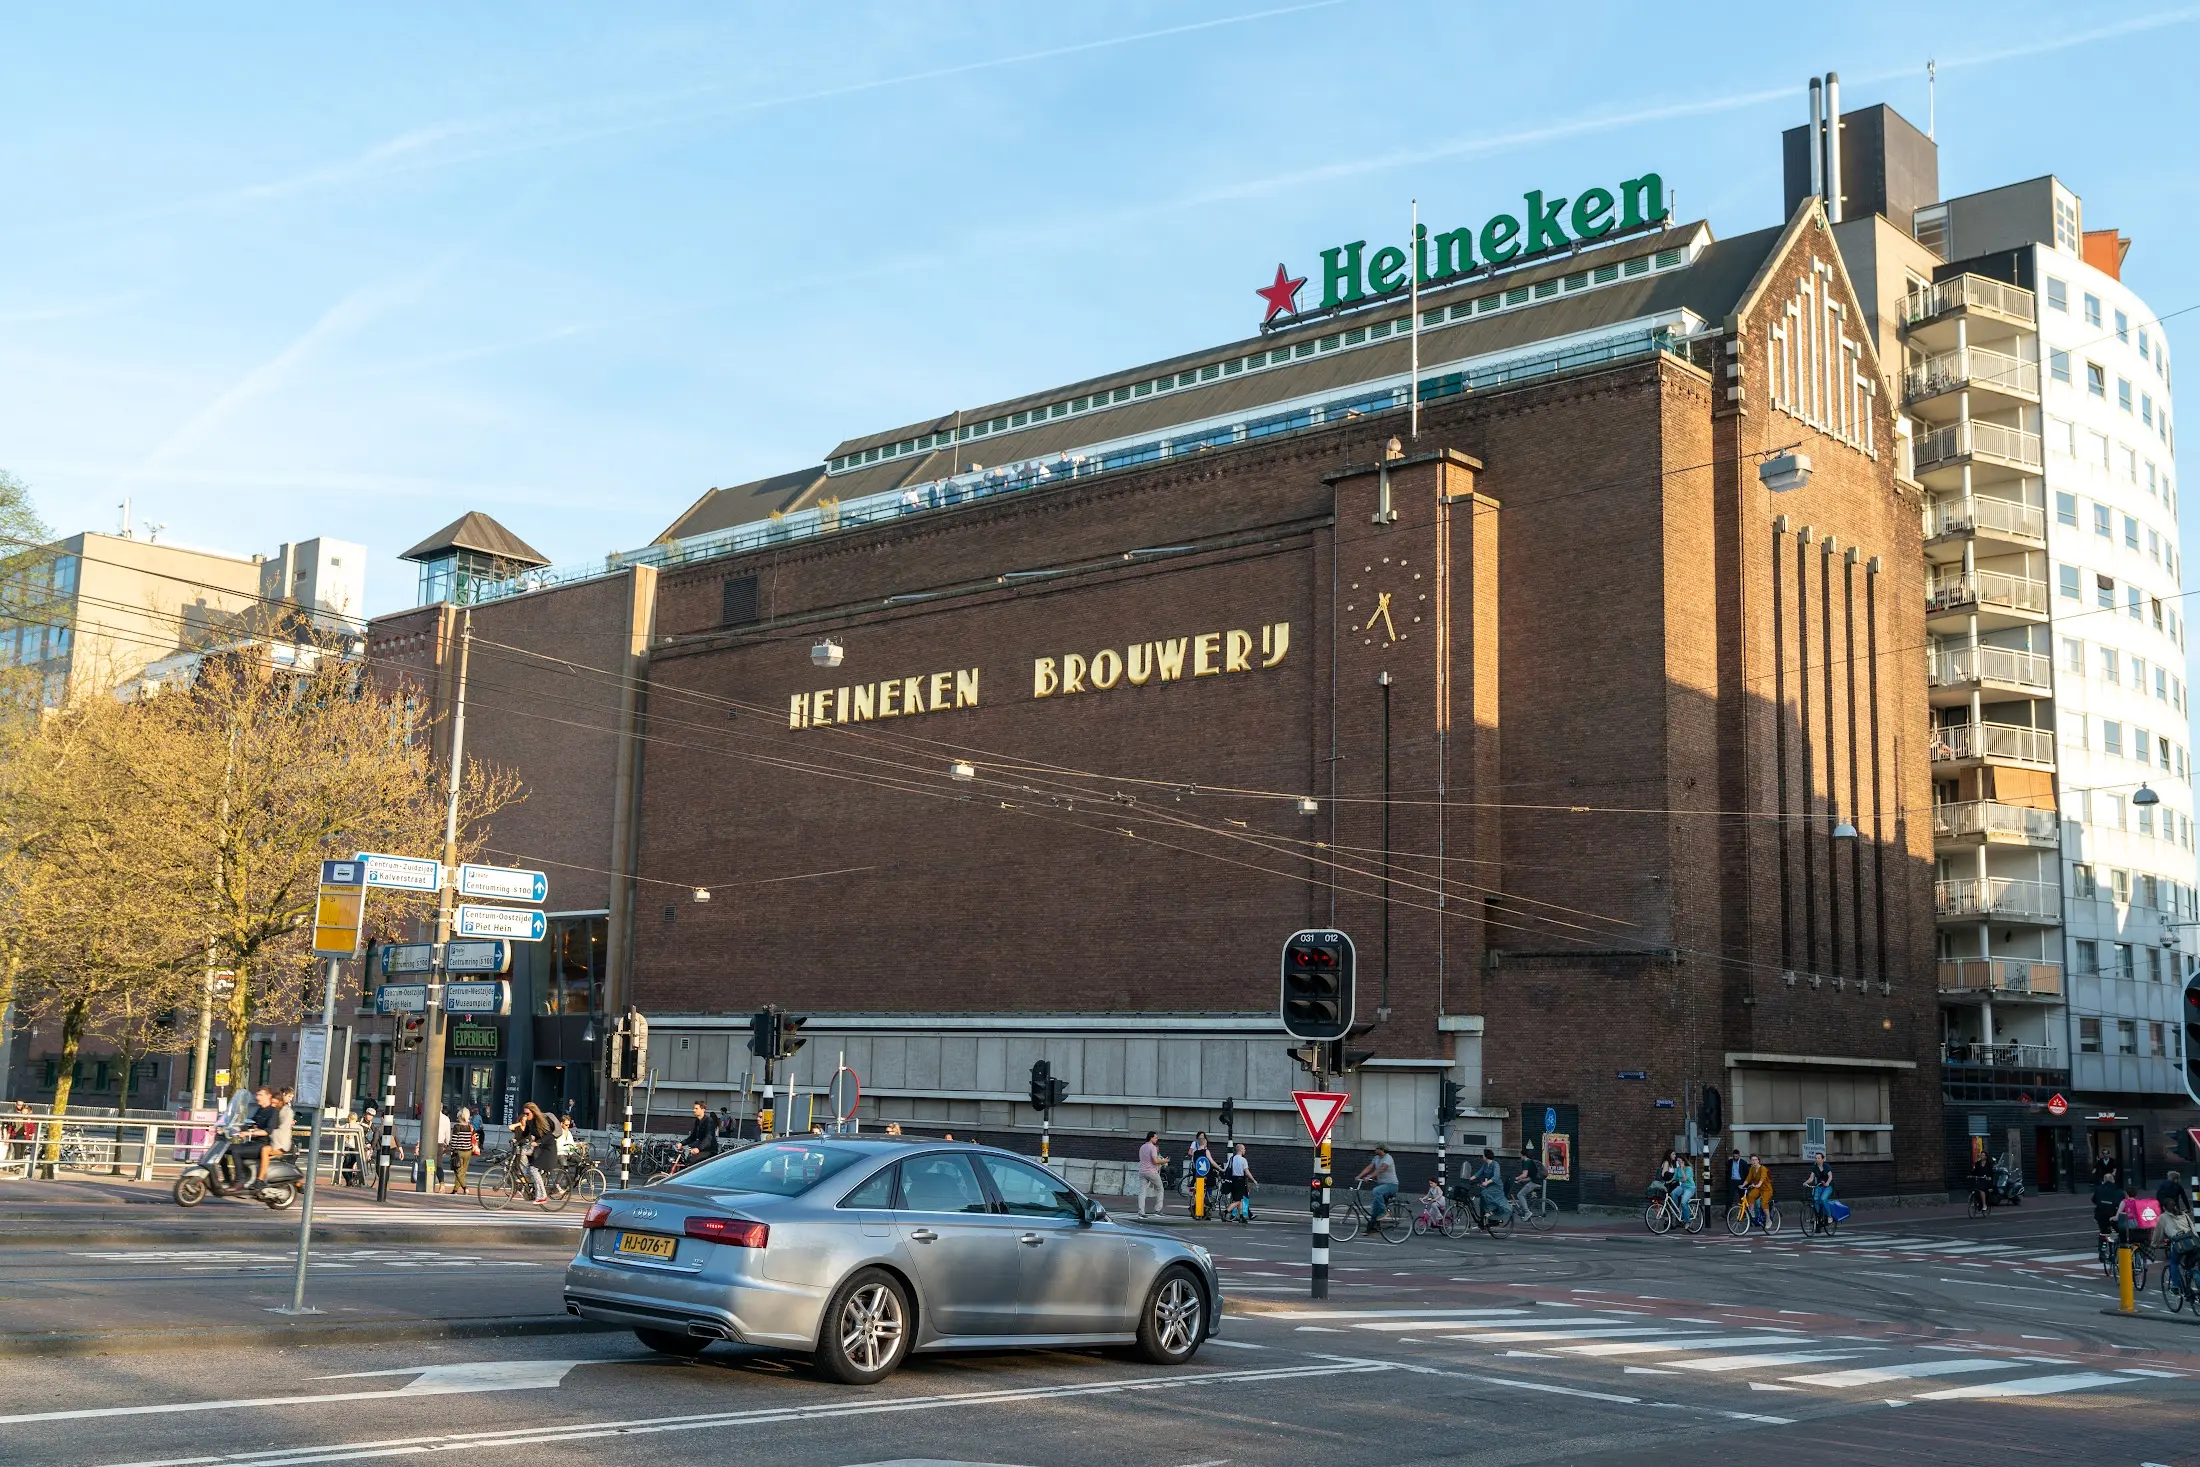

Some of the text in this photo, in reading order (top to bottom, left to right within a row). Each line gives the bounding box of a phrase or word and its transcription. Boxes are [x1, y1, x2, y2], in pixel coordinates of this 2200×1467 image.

[1319, 172, 1669, 308] Heineken
[789, 622, 1291, 731] HEINEKEN BROUWERIJ
[369, 860, 434, 874] Centrum-Zuidzijde
[379, 872, 426, 884] Kalverstraat
[466, 881, 510, 894] Centrumring
[465, 910, 532, 924] Centrum-Oostzijde
[475, 922, 491, 931] Piet
[493, 924, 512, 932] Hein
[1300, 934, 1339, 943] 031 012
[449, 958, 478, 967] Centrumring
[449, 987, 494, 997] Centrum-Westzijde
[401, 1000, 412, 1008] Hein
[455, 1000, 492, 1009] Museumplein
[455, 1030, 495, 1047] EXPERIENCE
[623, 1235, 671, 1254] HJ-076-T
